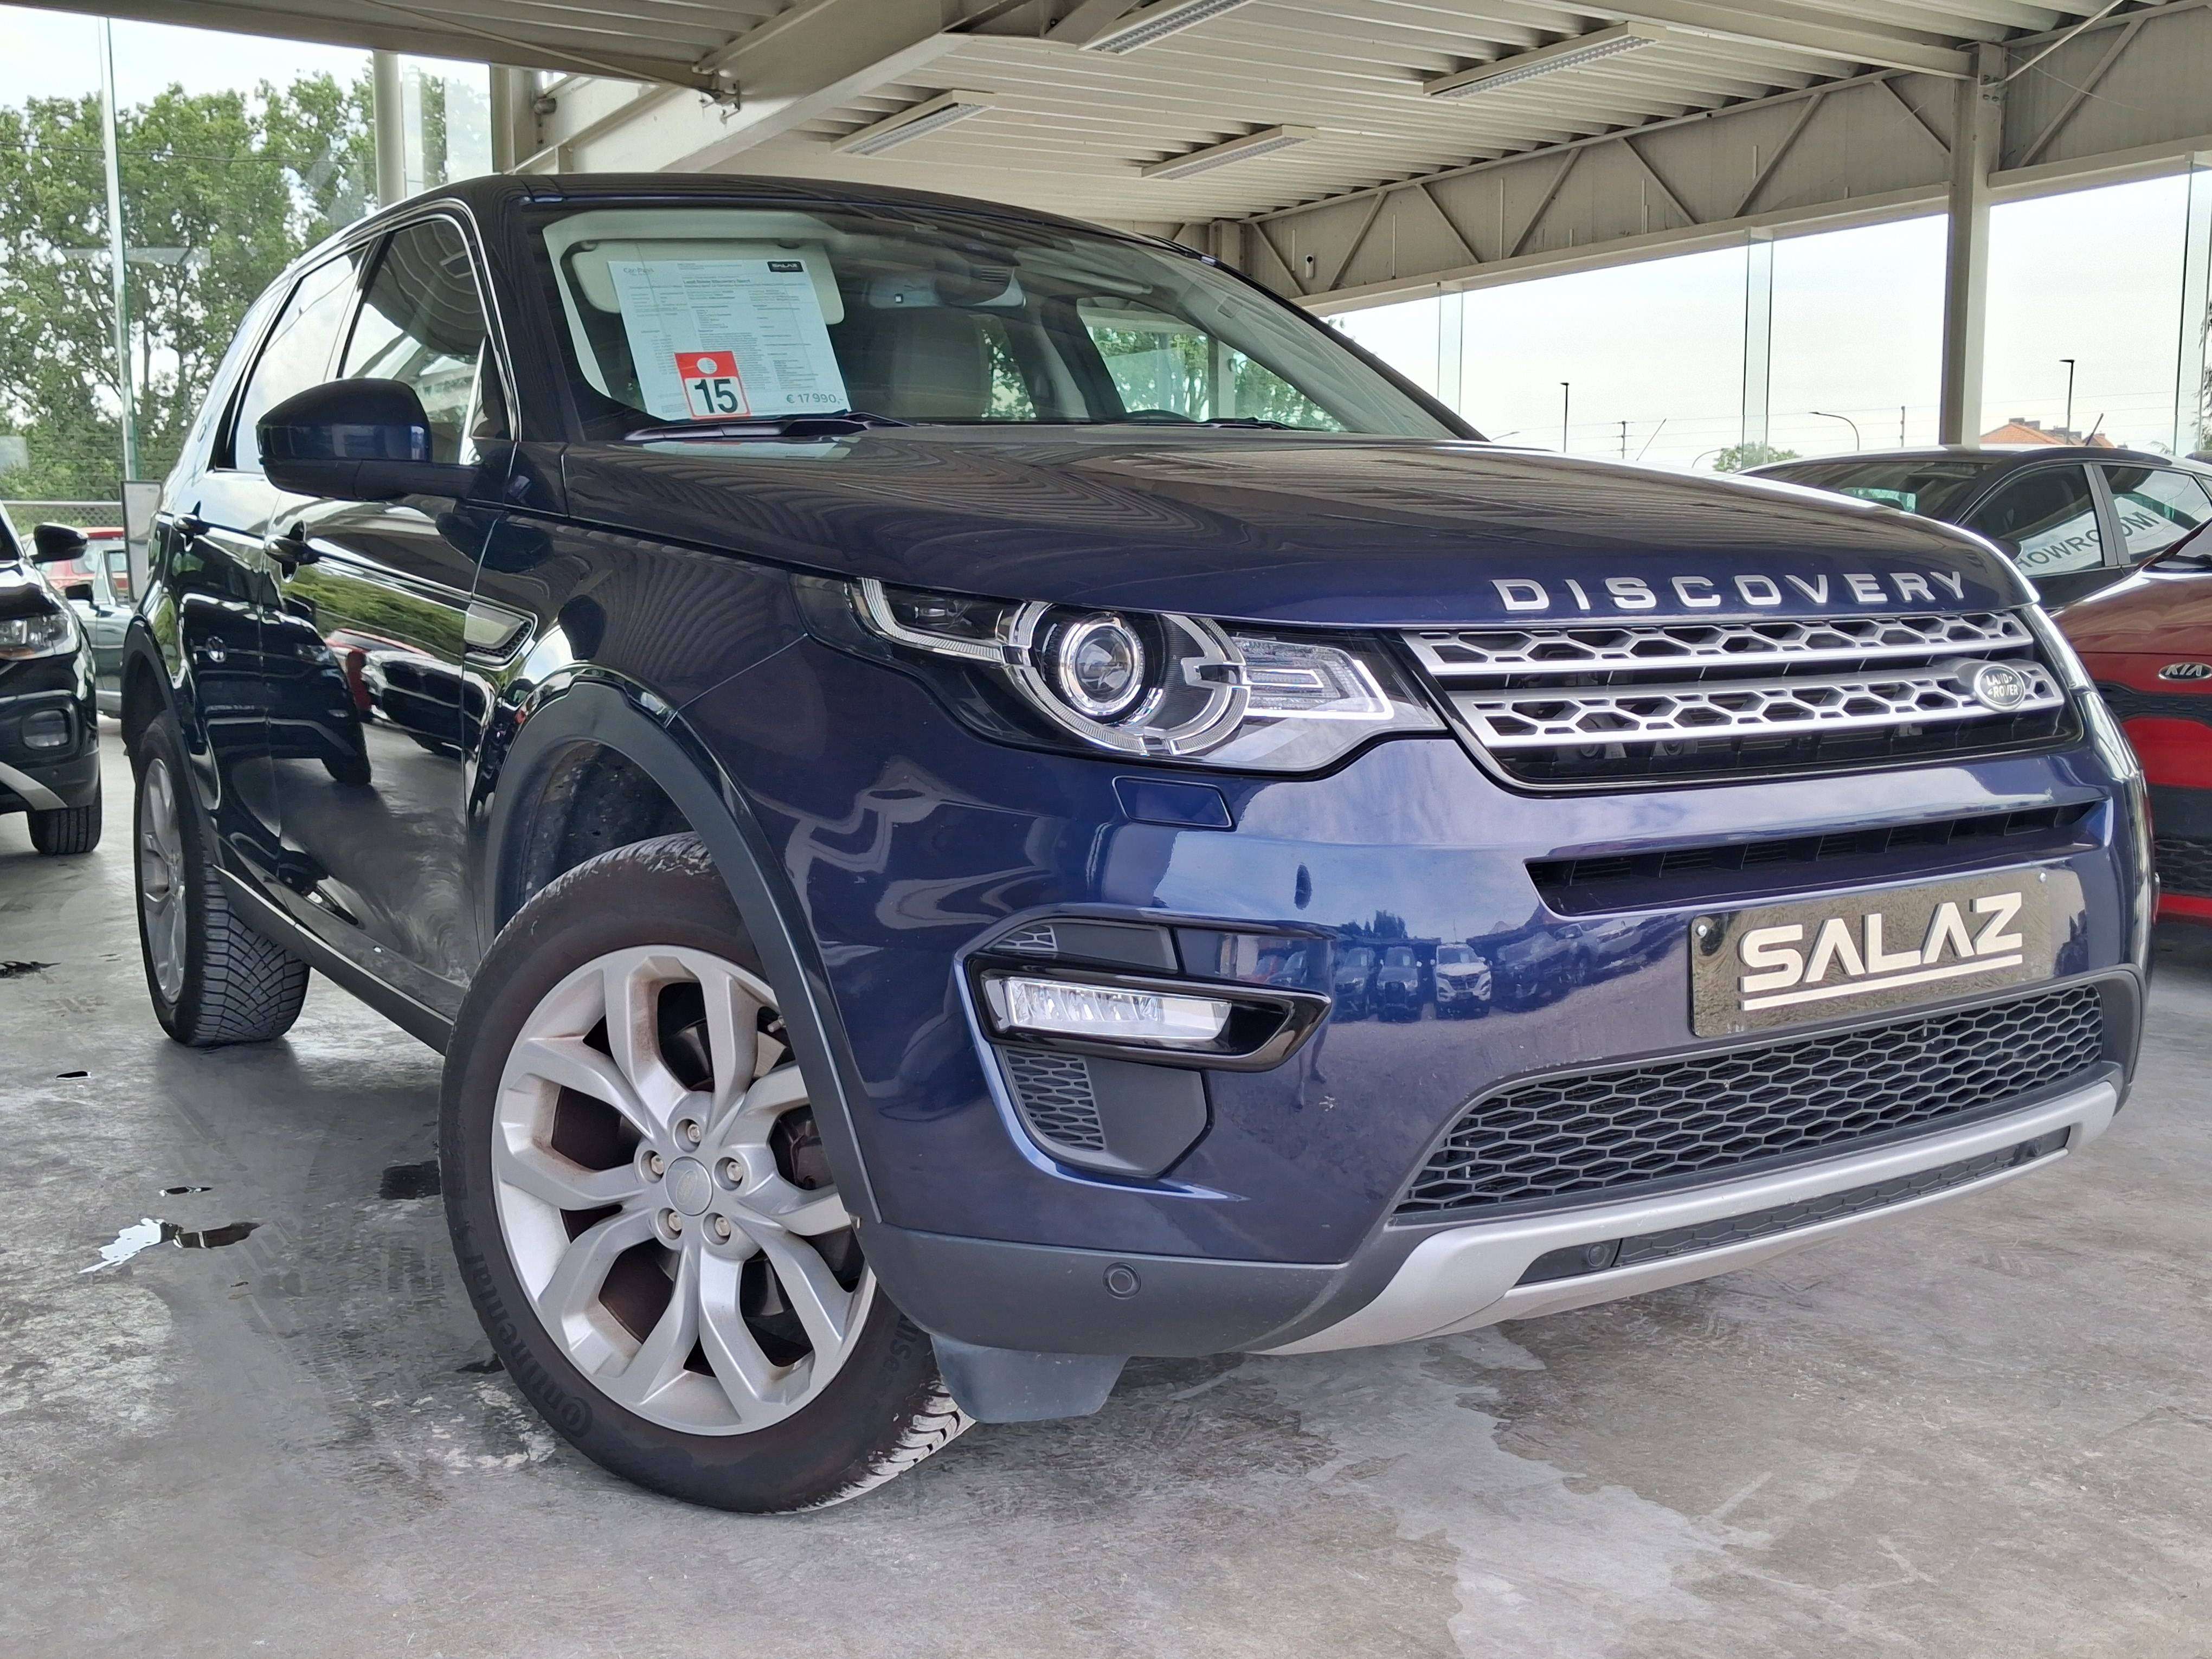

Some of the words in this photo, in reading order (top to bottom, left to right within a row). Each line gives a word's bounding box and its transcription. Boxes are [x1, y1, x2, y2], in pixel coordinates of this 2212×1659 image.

[694, 378, 738, 413] 15
[787, 394, 795, 403] €
[2015, 511, 2160, 570] HOWROOM
[1490, 571, 1964, 612] DISCOVERY
[1985, 673, 2010, 685] LAND
[2165, 664, 2203, 677] KIA
[1993, 684, 2020, 698] ROVER
[1739, 891, 2023, 993] SALAZ
